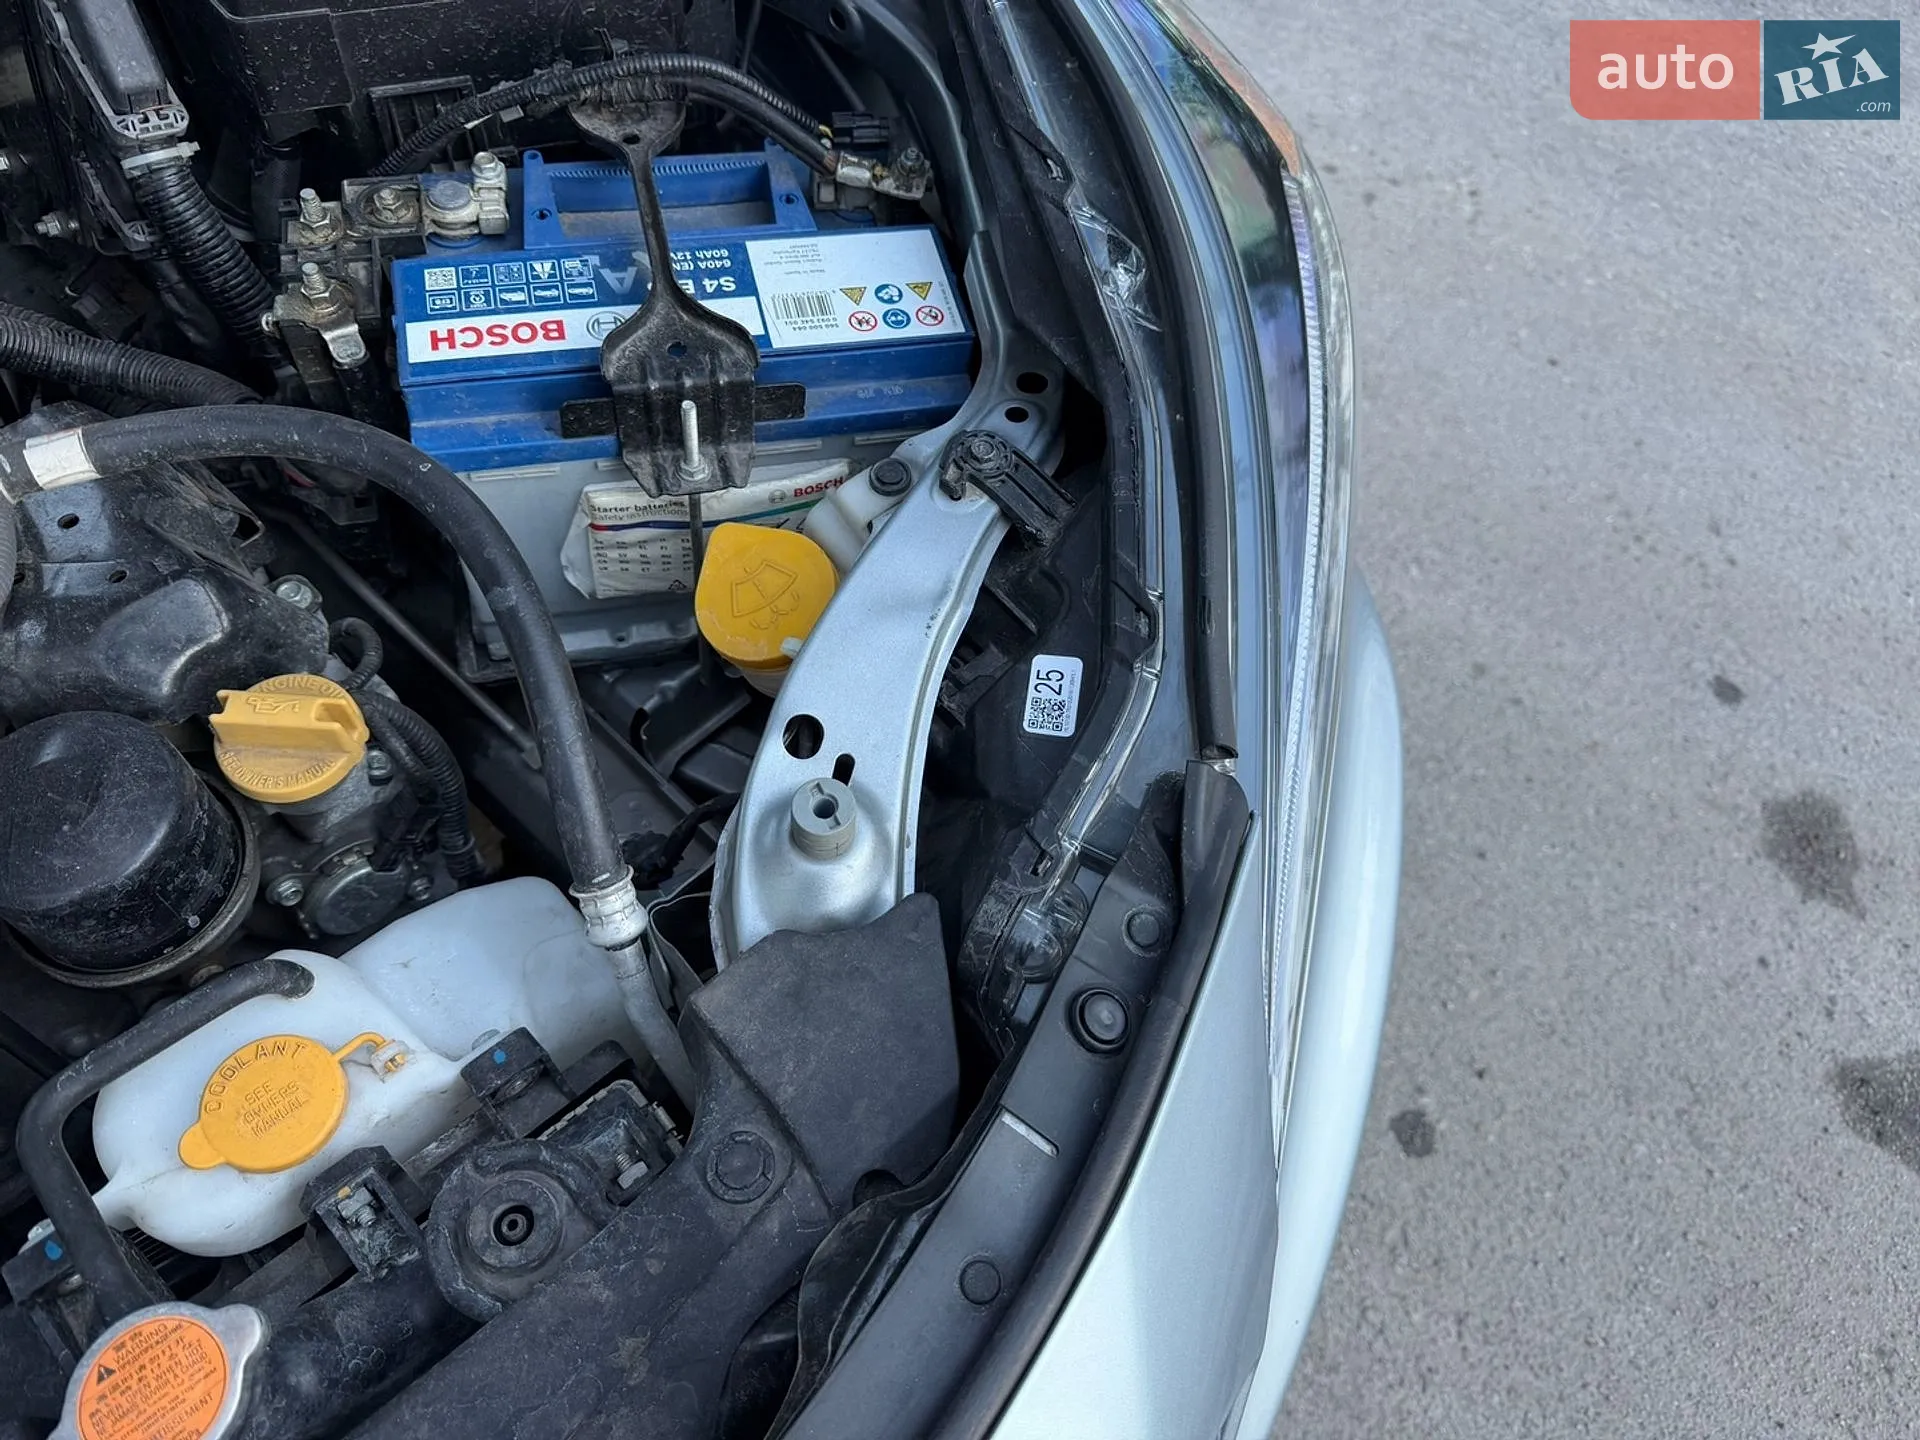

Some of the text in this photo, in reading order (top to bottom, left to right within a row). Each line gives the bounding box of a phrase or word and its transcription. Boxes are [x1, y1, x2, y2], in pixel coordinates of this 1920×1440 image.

[696, 248, 729, 259] 60Ah
[698, 259, 731, 270] 640A
[703, 276, 736, 293] S4
[430, 319, 566, 352] BOSCH
[793, 477, 845, 498] BOSCH
[590, 500, 686, 514] Starter batteries
[1034, 669, 1065, 696] 25
[220, 752, 238, 772] SEE
[286, 758, 337, 788] MANUAL
[204, 1040, 309, 1115] COOLANT
[242, 1081, 299, 1126] OWNERS
[244, 1080, 273, 1107] SEE
[250, 1096, 311, 1139] MANUAL
[113, 1322, 168, 1365] WARNING
